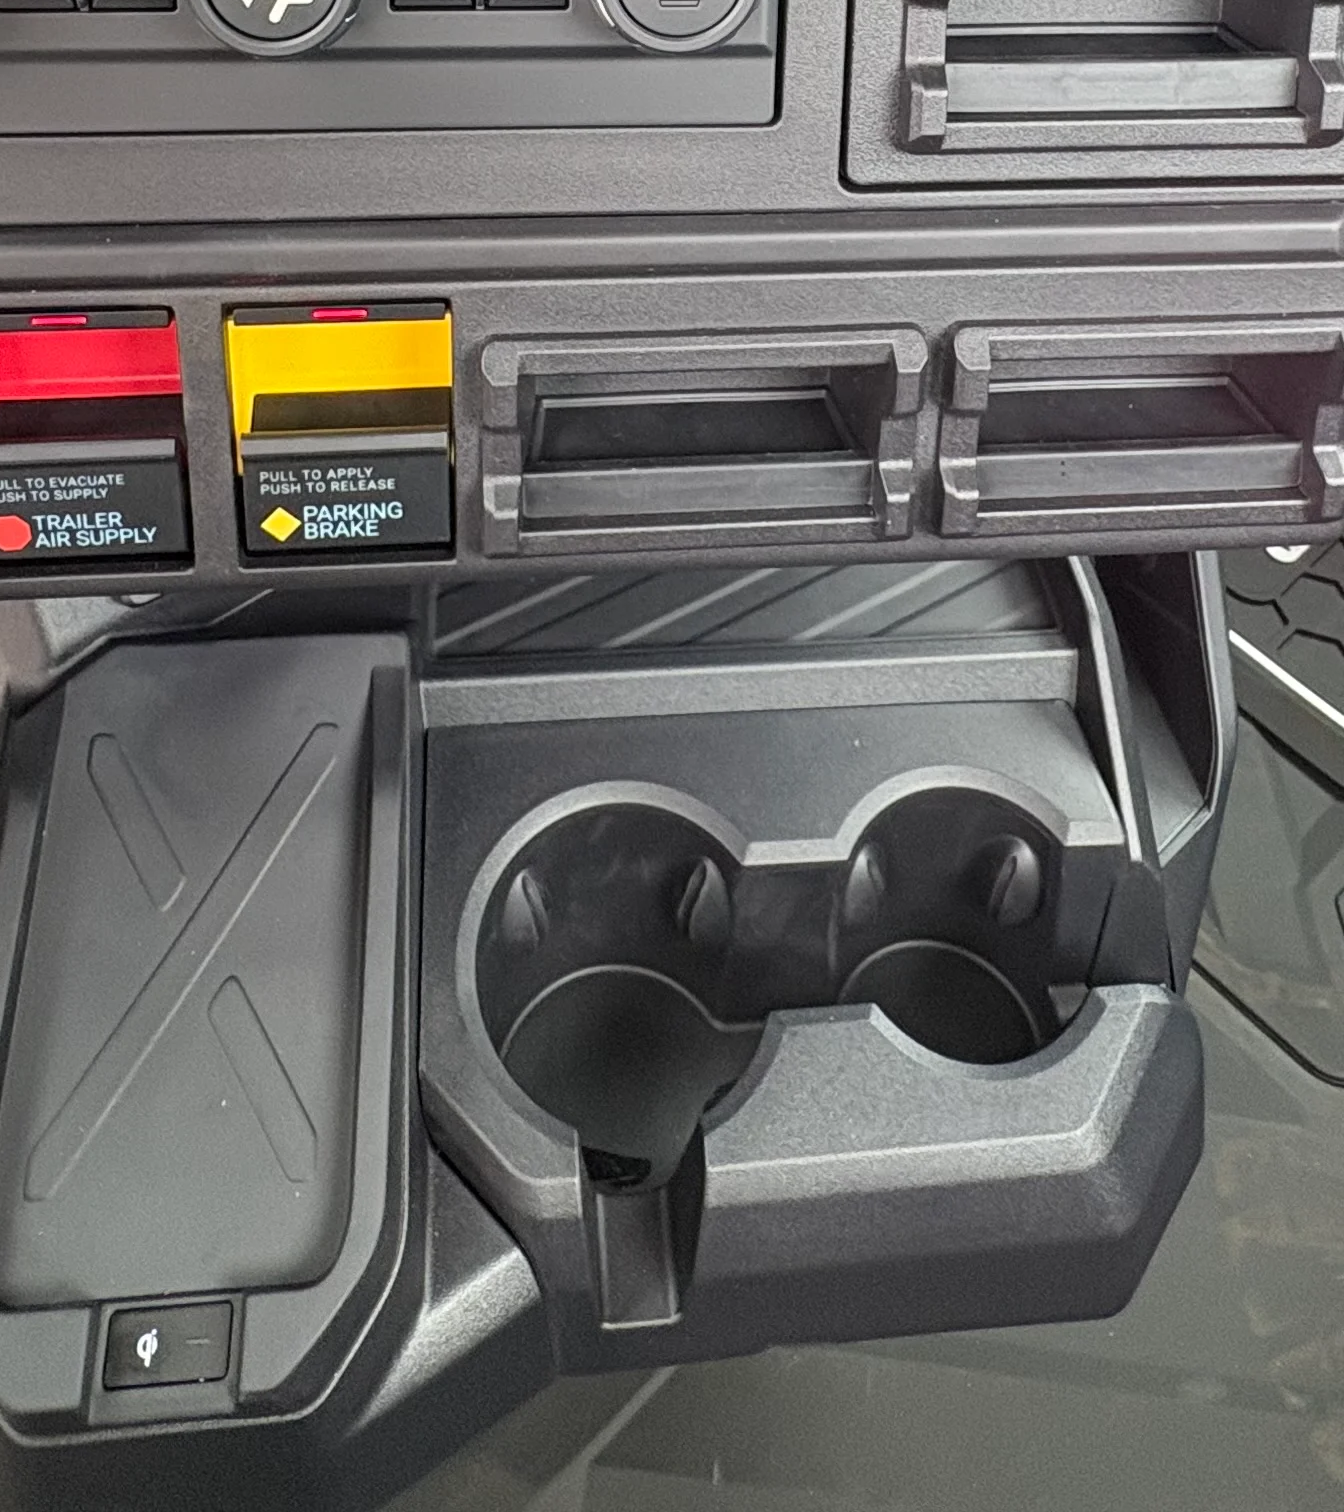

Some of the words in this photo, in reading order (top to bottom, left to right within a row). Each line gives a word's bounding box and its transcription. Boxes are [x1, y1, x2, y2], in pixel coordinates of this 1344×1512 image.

[25, 477, 46, 489] TO
[49, 473, 125, 488] EVACUATE
[259, 470, 297, 483] PULL
[301, 469, 322, 481] TO
[326, 466, 374, 479] APPLY
[31, 490, 51, 502] TO
[53, 487, 109, 501] SUPPLY
[259, 483, 301, 496] PUSH
[305, 481, 327, 494] TO
[330, 478, 397, 493] RELEASE
[32, 511, 124, 531] TRAILER
[303, 501, 404, 522] PARKING
[34, 530, 72, 549] AIR
[75, 526, 158, 548] SUPPLY
[304, 519, 380, 539] BRAKE
